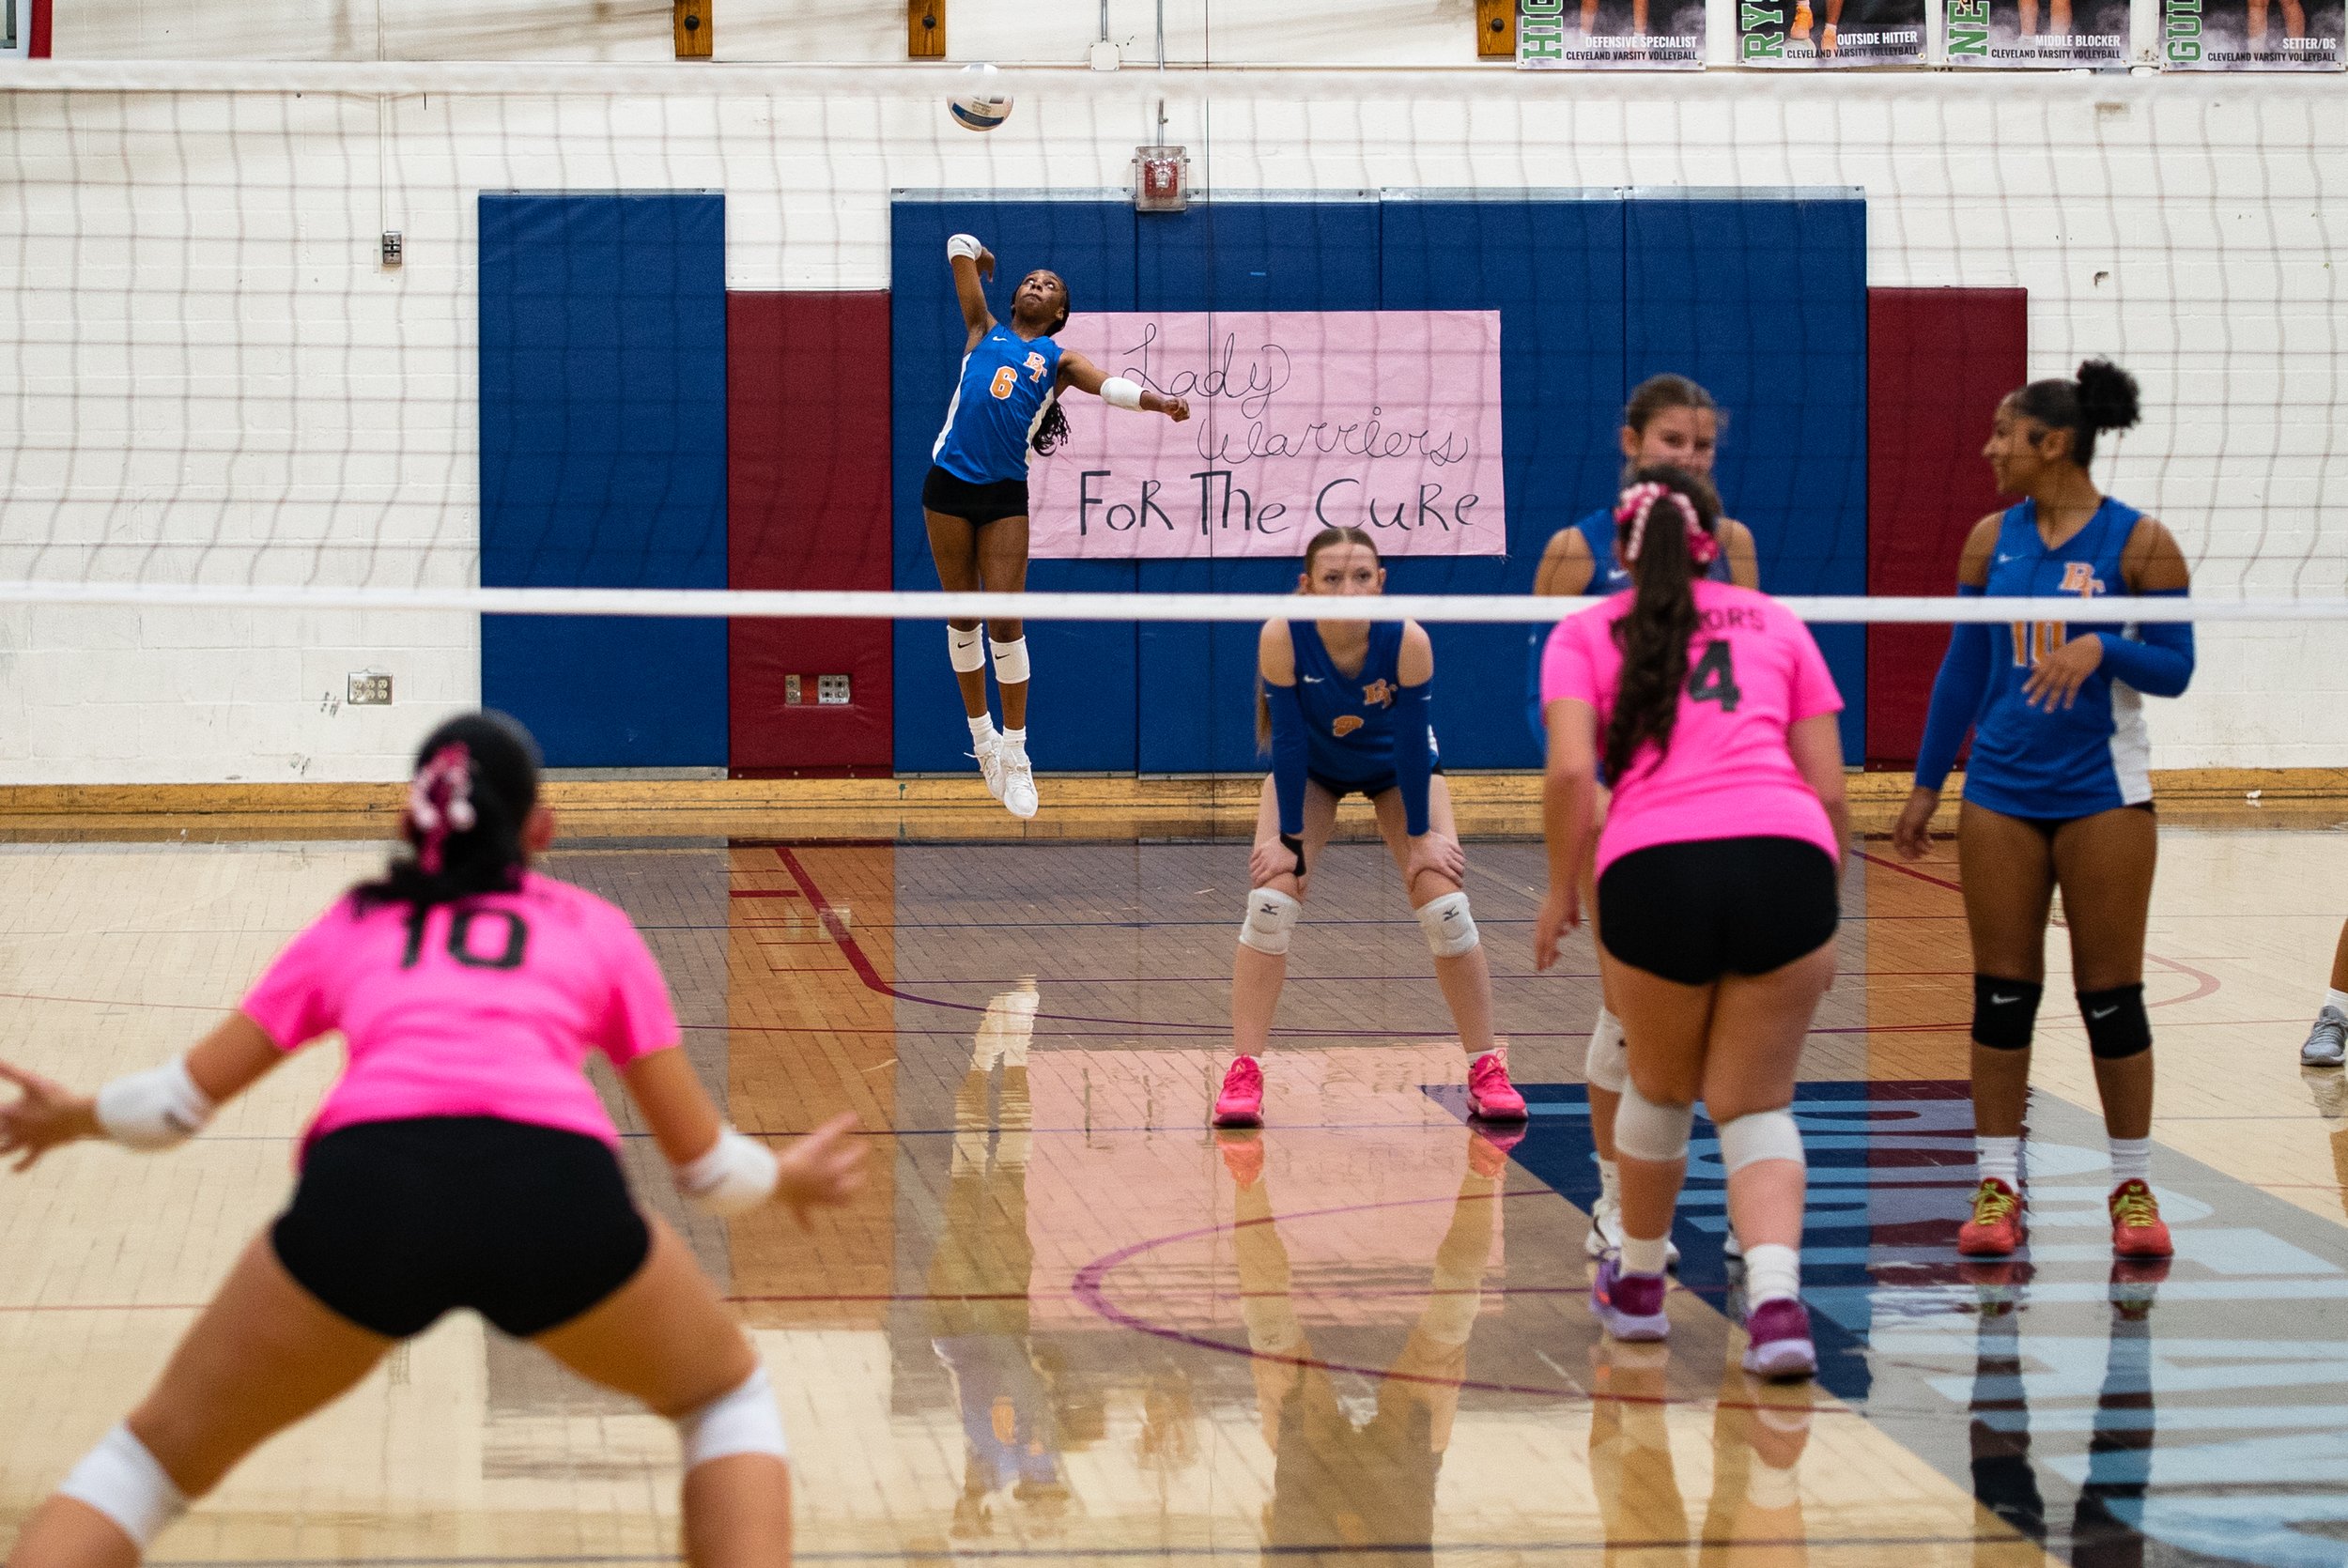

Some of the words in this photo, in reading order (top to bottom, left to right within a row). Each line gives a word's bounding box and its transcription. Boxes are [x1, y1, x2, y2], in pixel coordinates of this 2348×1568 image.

[1741, 0, 1784, 59] RY
[1584, 37, 1639, 48] DEFENSIVE
[1641, 36, 1697, 47] SPECIALIST
[1837, 33, 1879, 46] OUTSIDE
[1882, 31, 1918, 44] HITTER
[2035, 36, 2073, 47] MIDDLE
[2076, 35, 2121, 47] BLOCKER
[2282, 38, 2337, 50] SETTER/DS
[1566, 51, 1611, 60] CLEVELAND
[1613, 51, 1647, 60] VARSITY
[1648, 51, 1697, 60] VOLLEYBALL
[1786, 49, 1831, 58] CLEVELAND
[1833, 48, 1867, 57] VARSITY
[1869, 46, 1919, 56] VOLLEYBALL
[1991, 49, 2036, 59] CLEVELAND
[2037, 49, 2072, 58] VARSITY
[2073, 49, 2121, 59] VOLLEYBALL
[2207, 53, 2252, 62] CLEVELAND
[2253, 52, 2287, 62] VARSITY
[2289, 52, 2337, 62] VOLLEYBALL
[1122, 322, 1291, 419] Lady
[989, 365, 1018, 400] 6
[1190, 469, 1290, 536] The
[1689, 639, 1742, 712] 4
